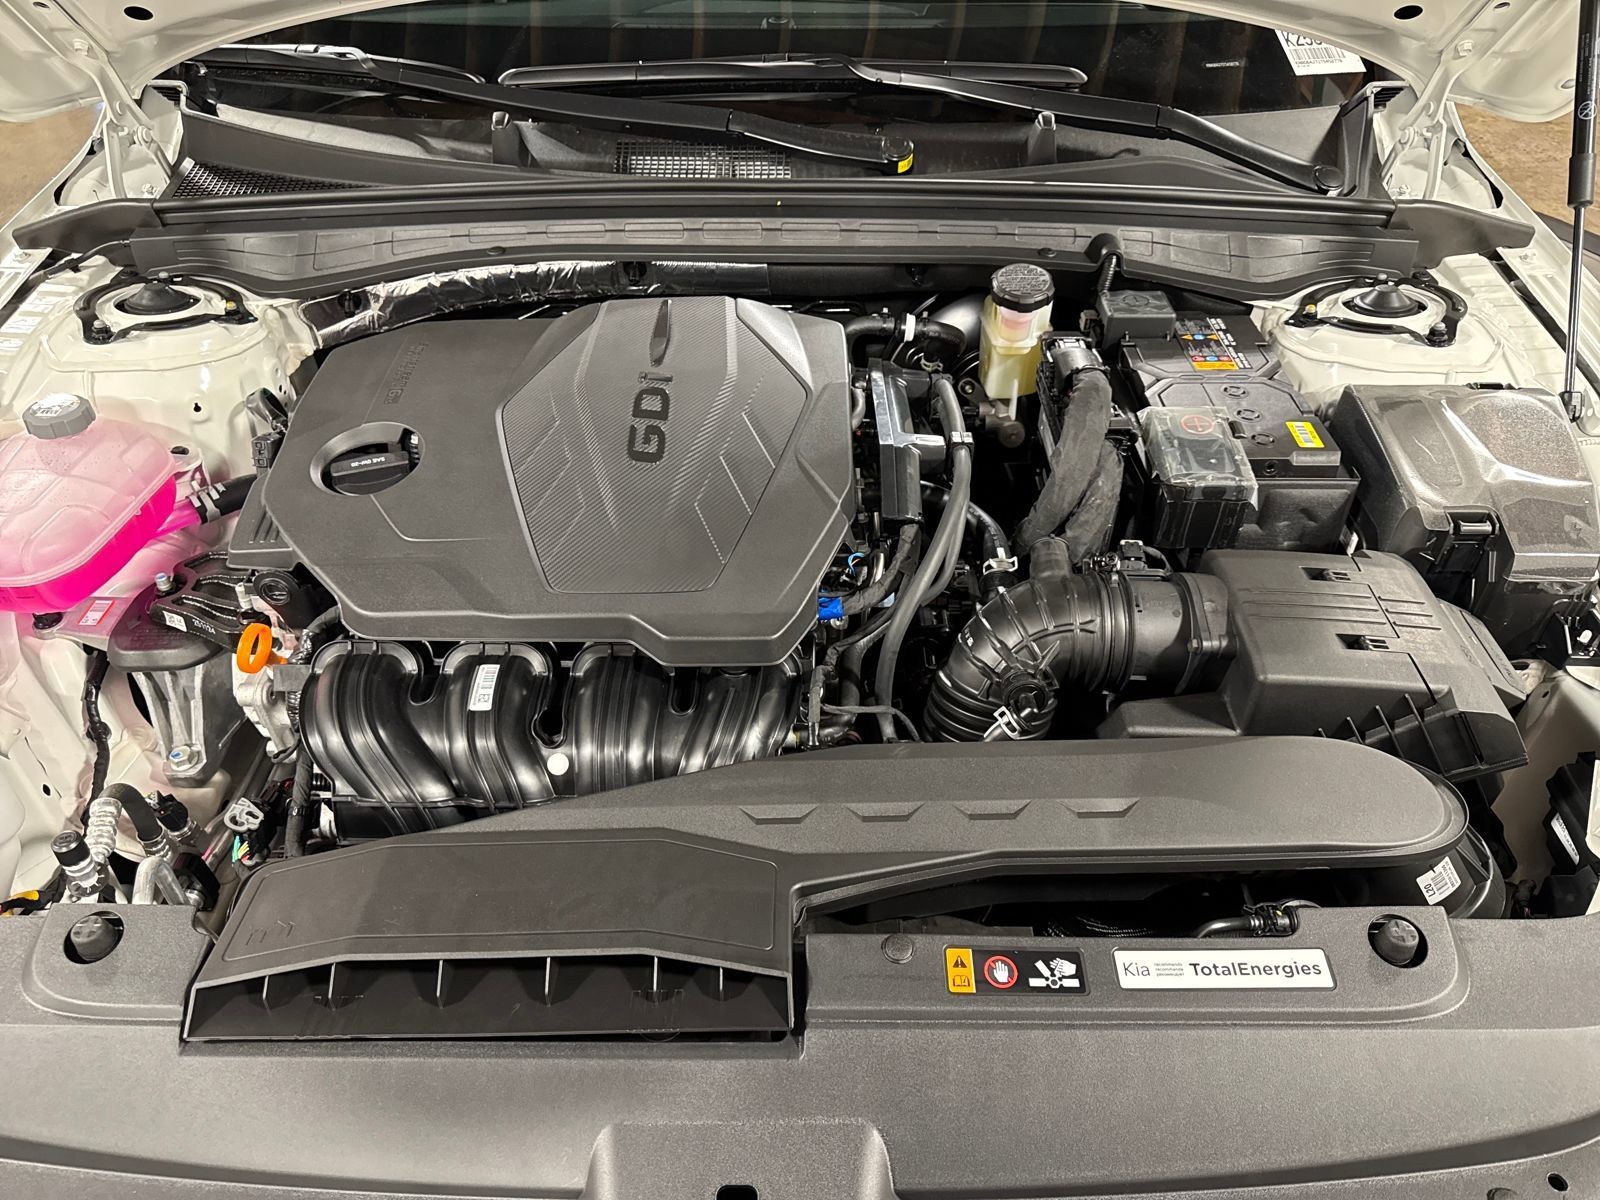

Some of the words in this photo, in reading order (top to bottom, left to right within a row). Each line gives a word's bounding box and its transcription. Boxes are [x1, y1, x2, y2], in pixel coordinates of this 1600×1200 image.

[627, 371, 673, 463] GDi
[1424, 883, 1436, 898] L20
[1122, 962, 1150, 977] Kia
[1189, 961, 1322, 978] TotalEnergies
